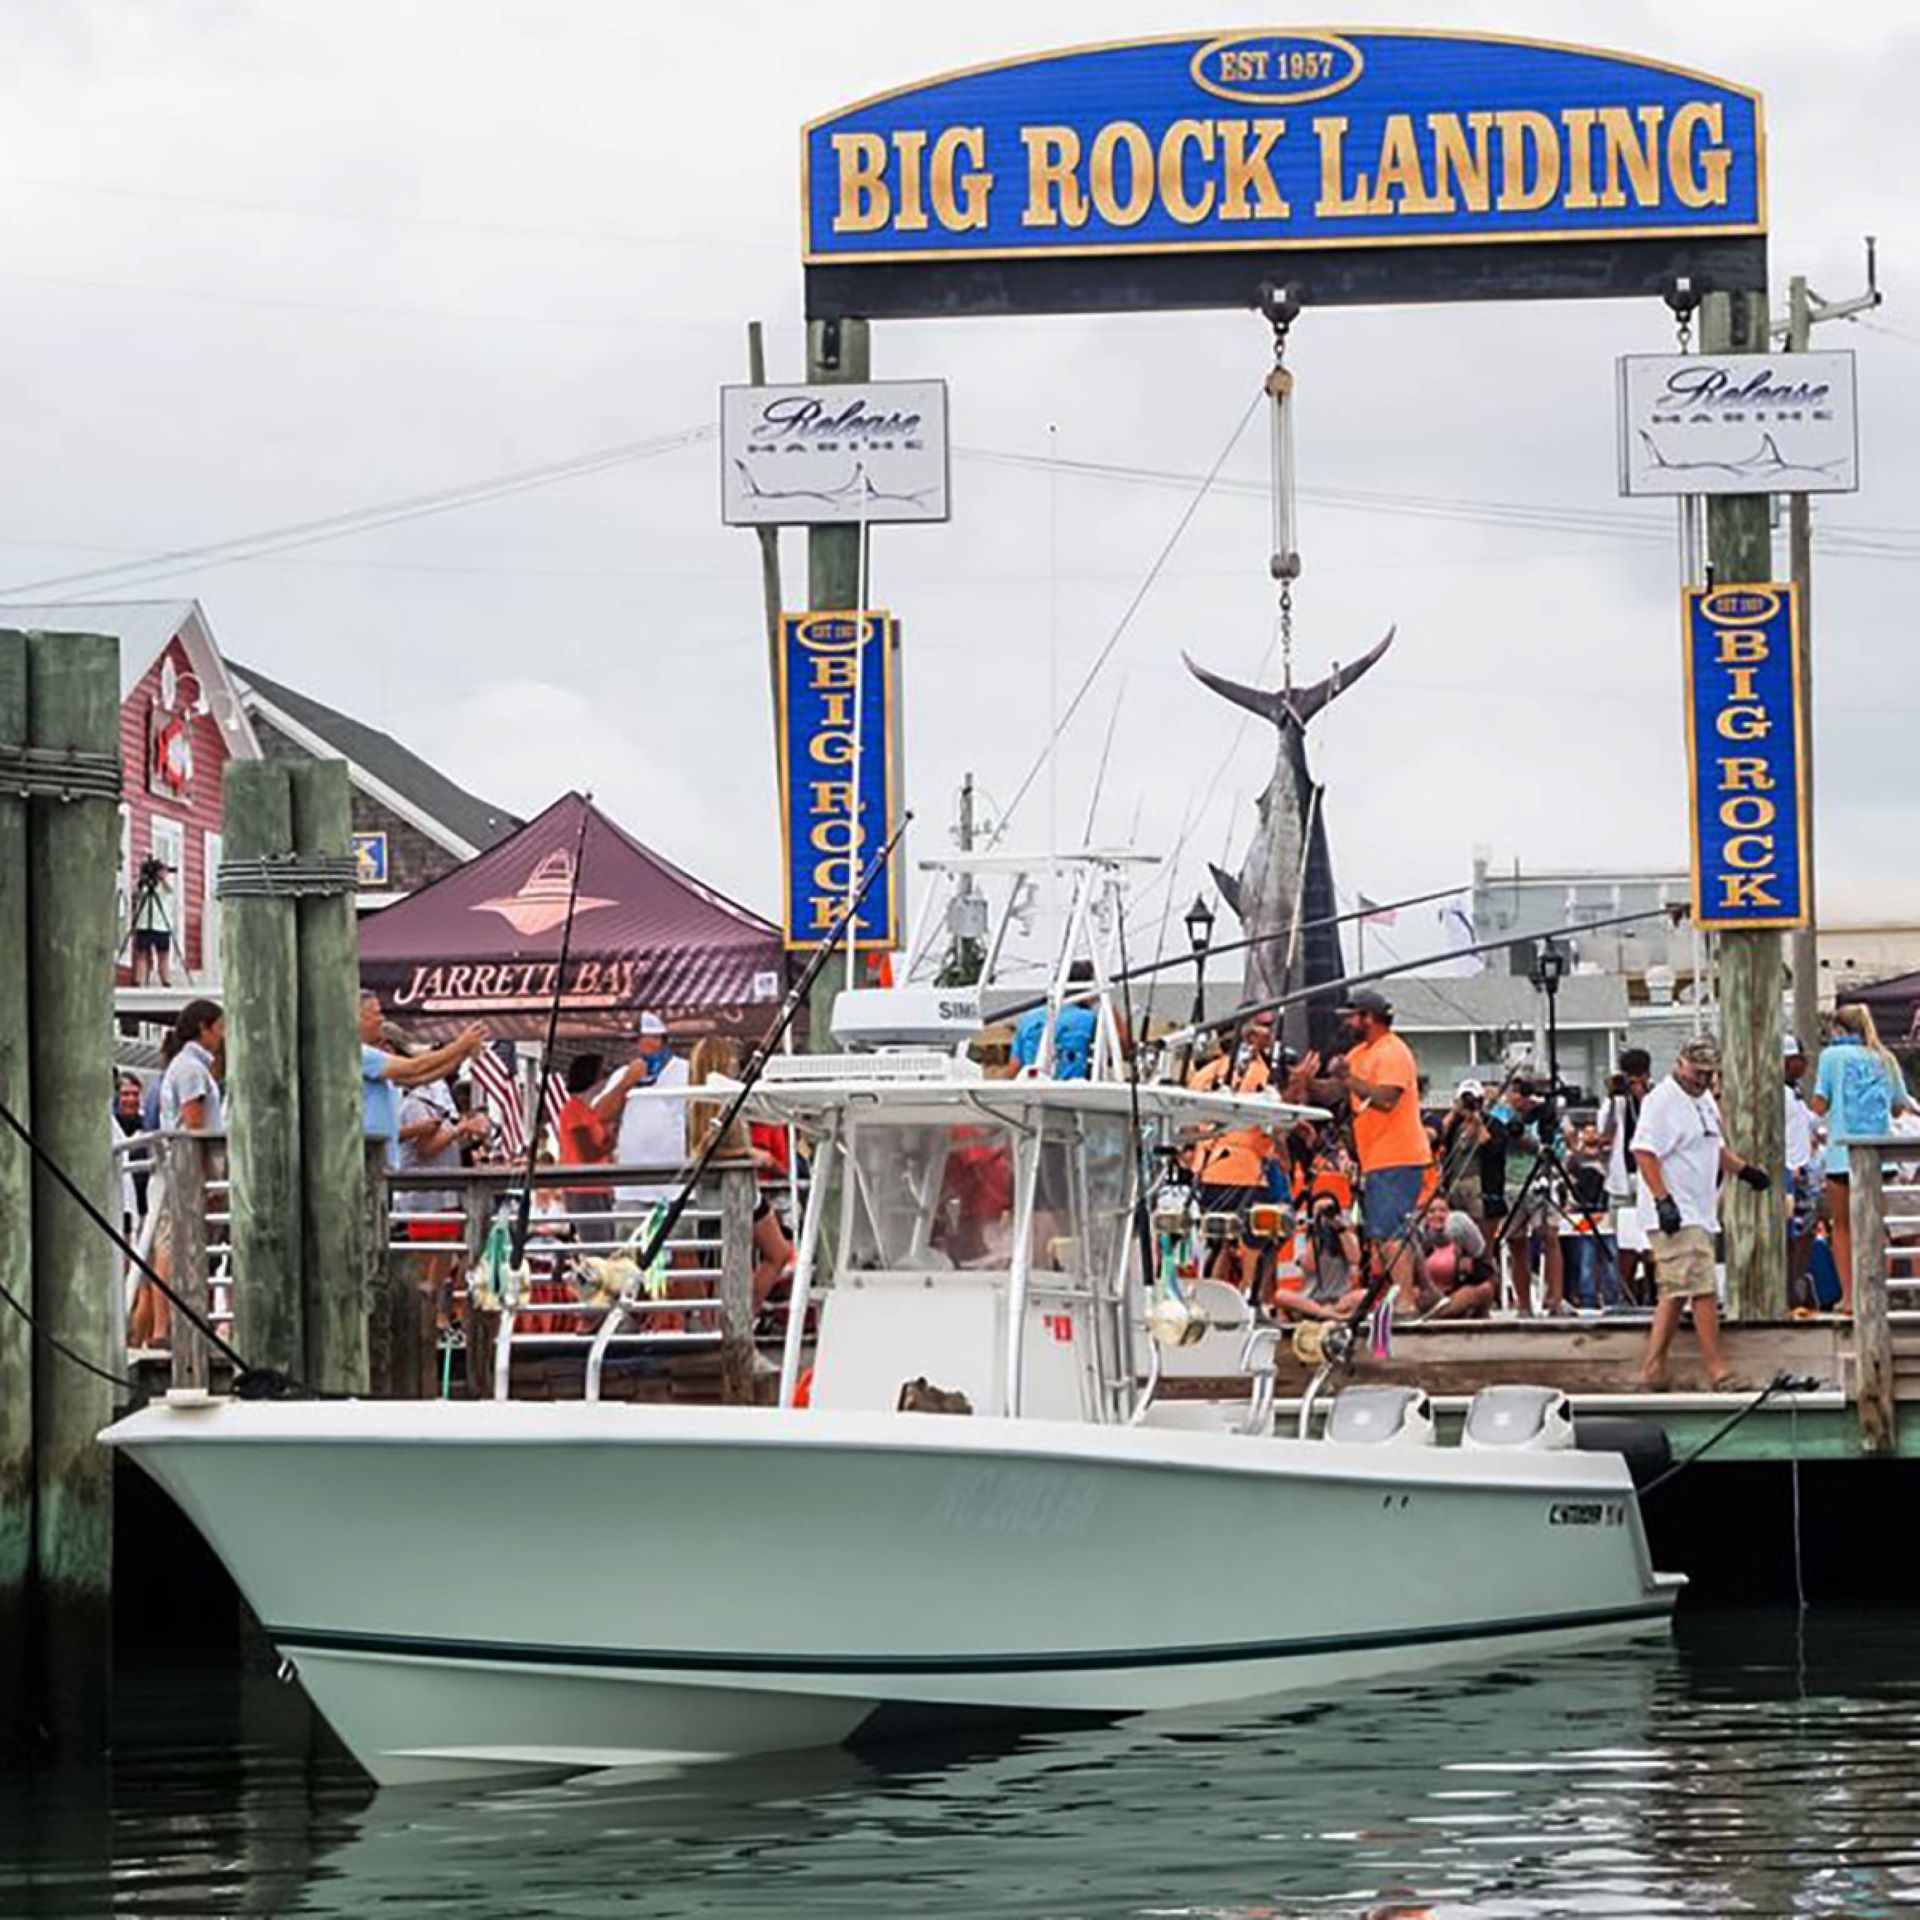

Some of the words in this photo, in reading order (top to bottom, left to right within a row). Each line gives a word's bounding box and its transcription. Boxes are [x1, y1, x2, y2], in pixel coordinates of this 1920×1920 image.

[1219, 52, 1269, 81] EST
[1278, 51, 1333, 80] 1957
[832, 125, 994, 233] BIG
[1021, 117, 1291, 229] ROCK
[1312, 101, 1734, 219] LANDING
[808, 656, 865, 765] BIG
[1714, 629, 1773, 741] BIG
[808, 781, 870, 929] ROCK
[1716, 757, 1781, 907] ROCK
[393, 964, 559, 1004] JARRETT
[571, 958, 649, 998] BAY
